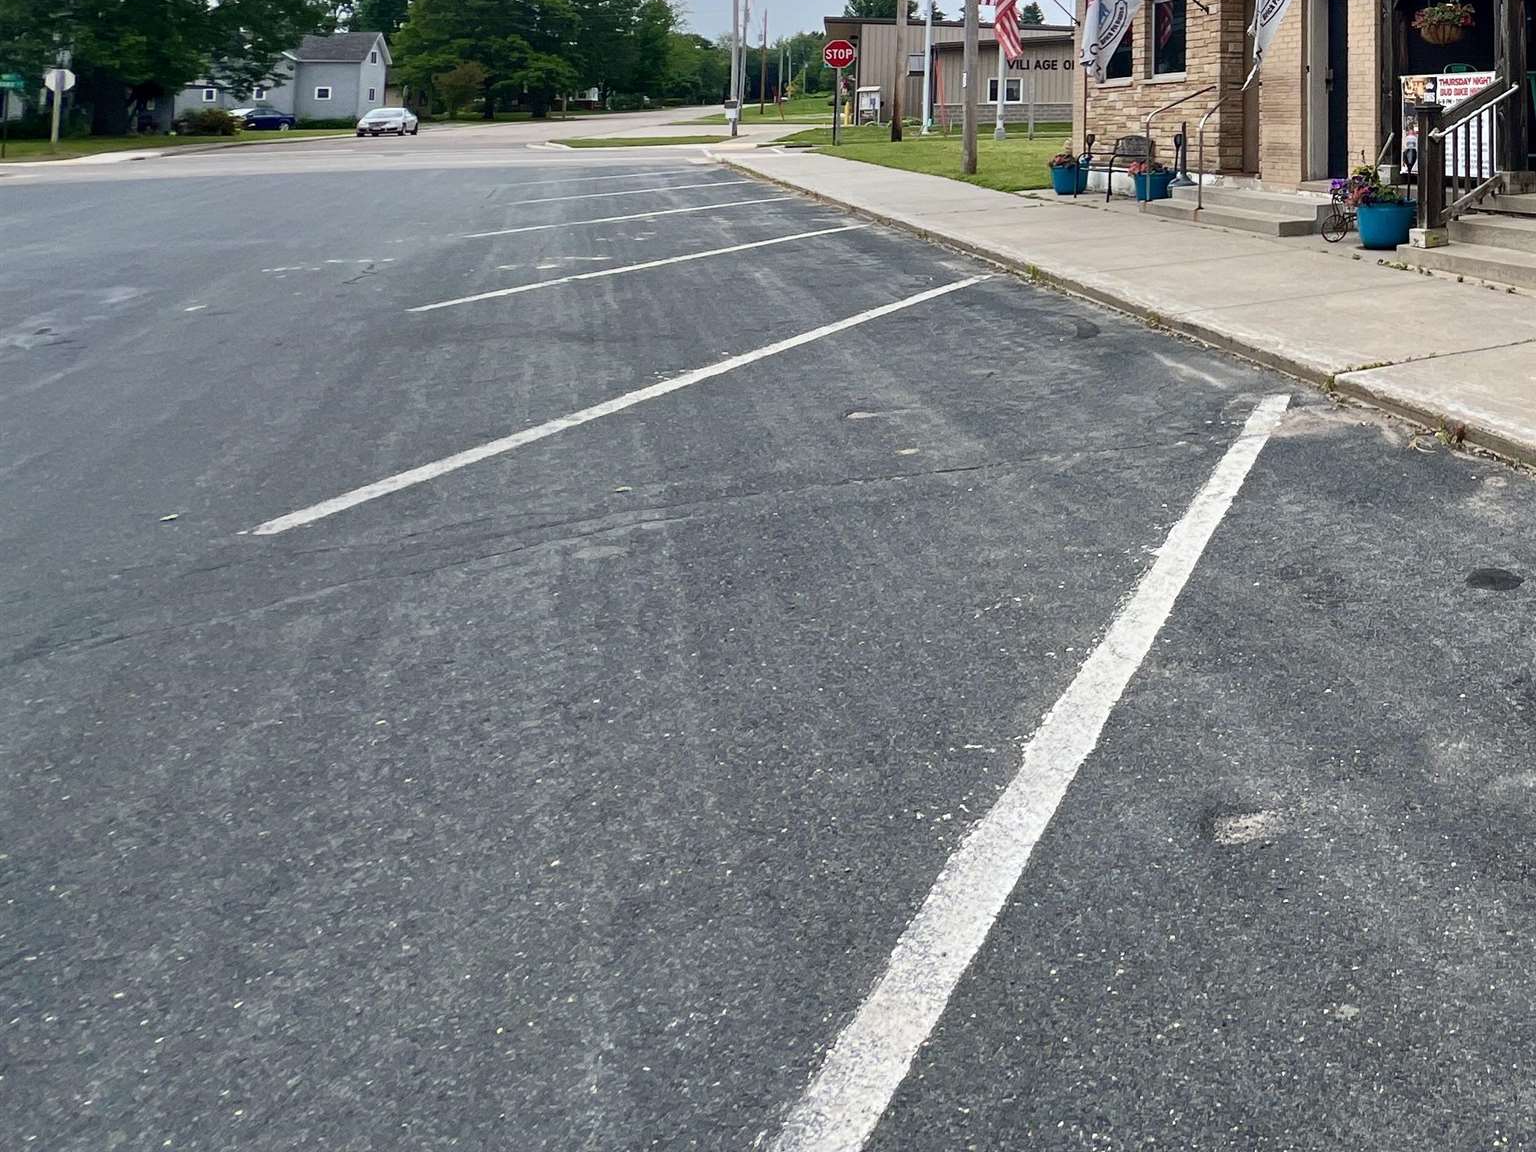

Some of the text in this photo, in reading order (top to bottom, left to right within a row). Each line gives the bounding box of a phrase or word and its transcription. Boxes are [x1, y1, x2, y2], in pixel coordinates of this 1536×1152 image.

[825, 48, 853, 60] STOP
[1439, 76, 1492, 86] THURSDAY NIGHT
